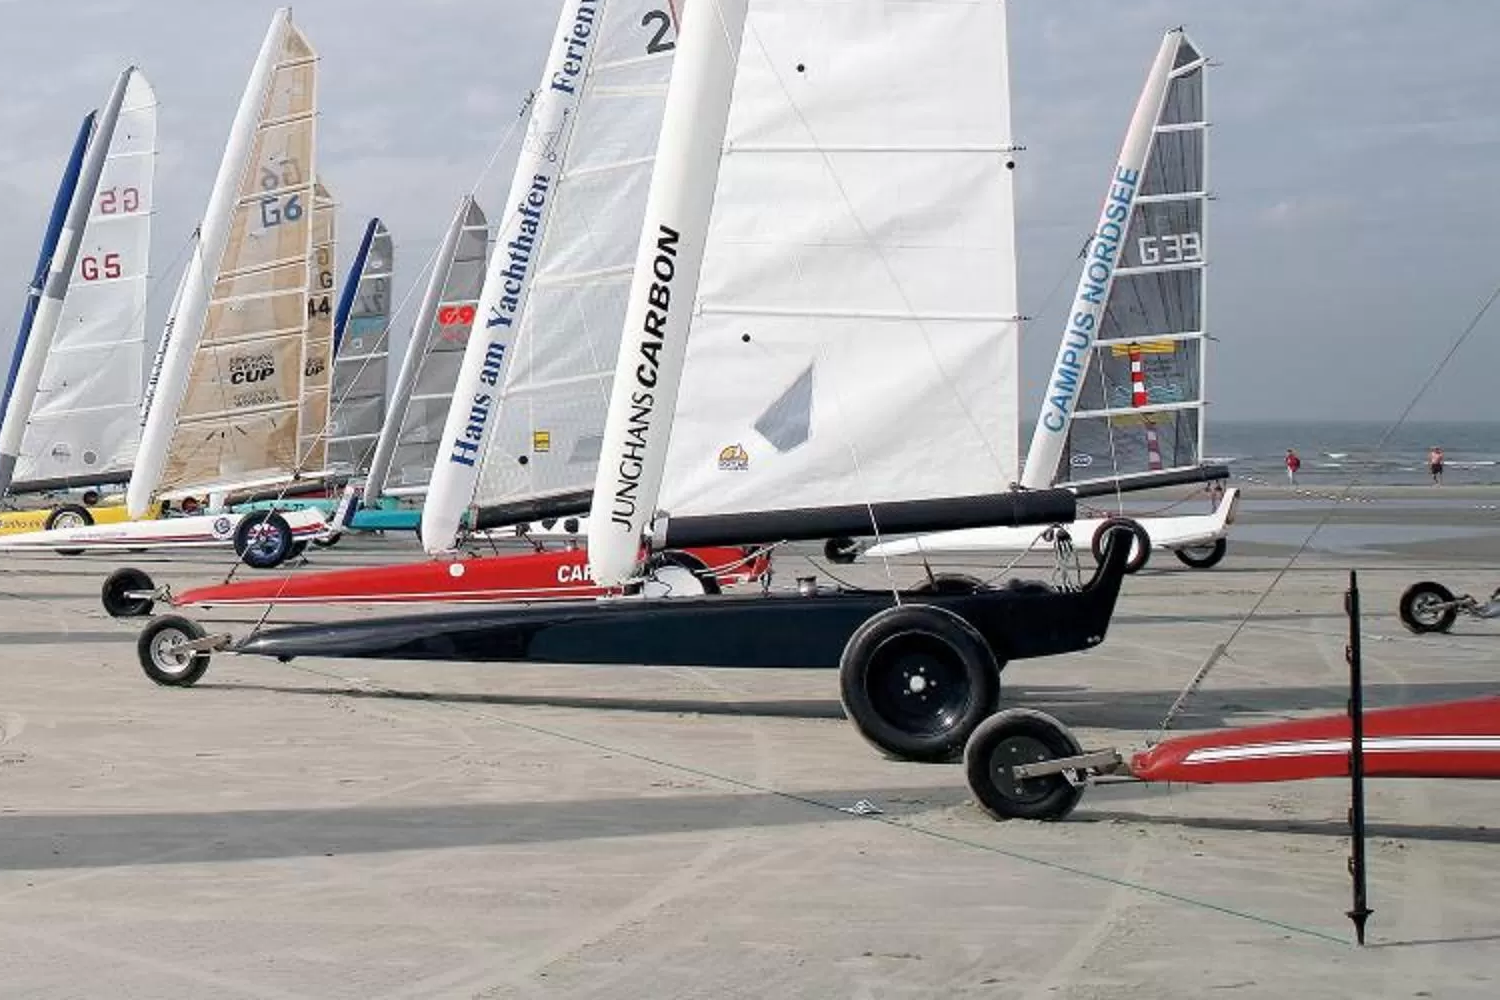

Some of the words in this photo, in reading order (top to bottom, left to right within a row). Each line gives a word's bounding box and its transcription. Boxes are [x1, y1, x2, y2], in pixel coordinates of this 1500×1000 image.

[262, 194, 302, 228] G6
[486, 173, 550, 329] Yachthafen
[1082, 166, 1139, 304] NORDSEE
[231, 367, 275, 385] CUP
[480, 341, 506, 387] am
[611, 392, 654, 532] JUNGHANS
[637, 225, 680, 389] CARBON
[1043, 311, 1095, 432] CAMPUS
[450, 392, 491, 468] Haus
